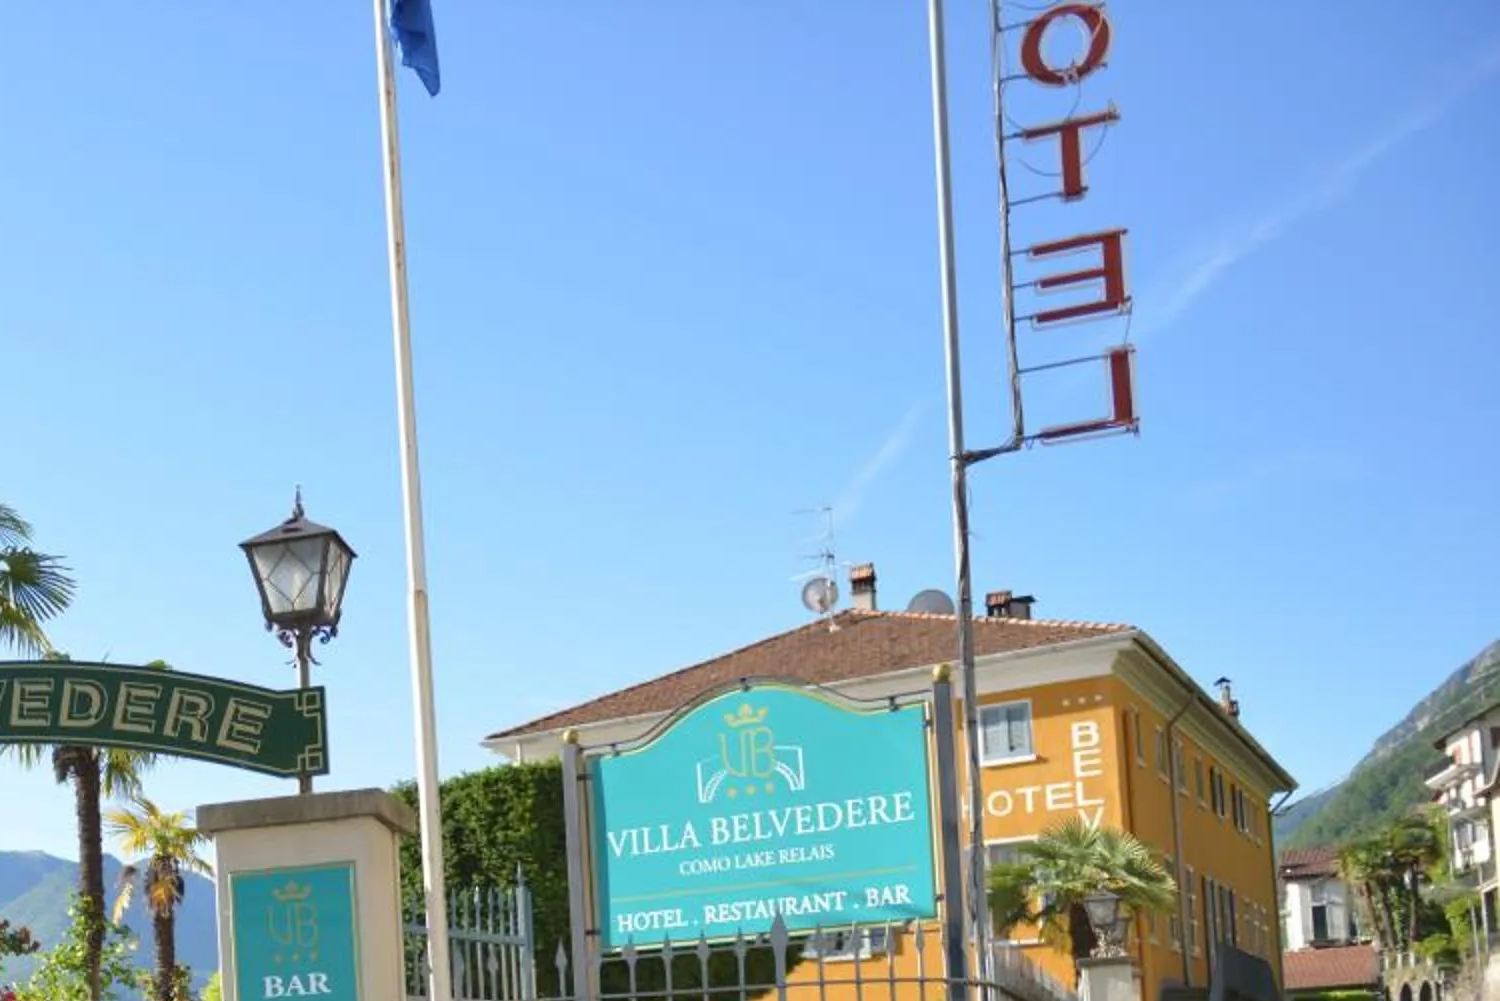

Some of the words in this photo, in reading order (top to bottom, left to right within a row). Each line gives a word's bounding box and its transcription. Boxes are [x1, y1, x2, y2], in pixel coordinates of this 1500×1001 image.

[607, 820, 701, 858] VILLA
[711, 791, 916, 846] BELVEDERE
[679, 856, 731, 876] COMO
[735, 850, 775, 869] LAKE
[779, 843, 835, 864] RELAIS
[617, 910, 689, 932] HOTEL
[703, 891, 847, 924] RESTAURANT
[866, 884, 912, 908] BAR
[263, 972, 333, 999] BAR
